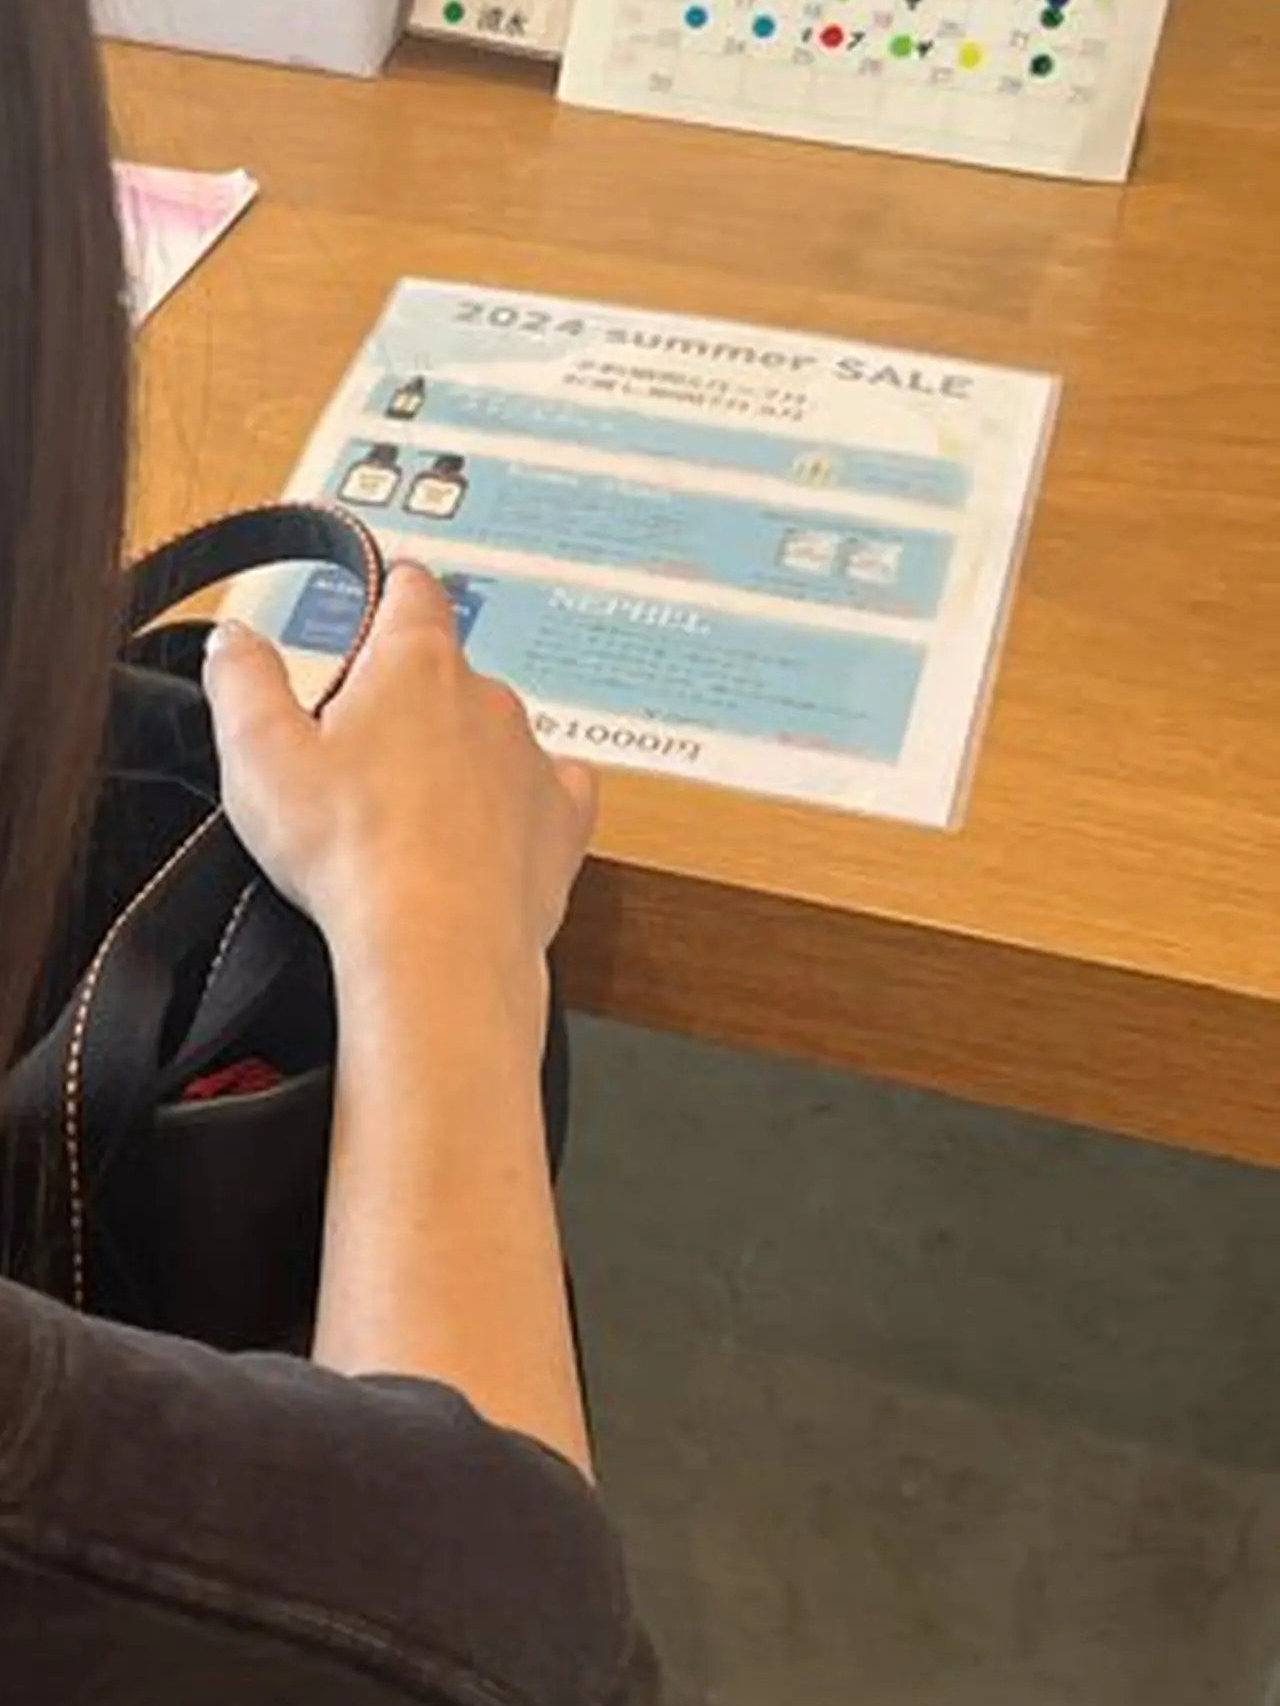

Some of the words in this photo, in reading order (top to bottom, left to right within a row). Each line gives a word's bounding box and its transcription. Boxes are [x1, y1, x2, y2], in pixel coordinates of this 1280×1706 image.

[452, 299, 586, 339] 2024
[603, 326, 820, 375] summer
[834, 357, 976, 401] SALE
